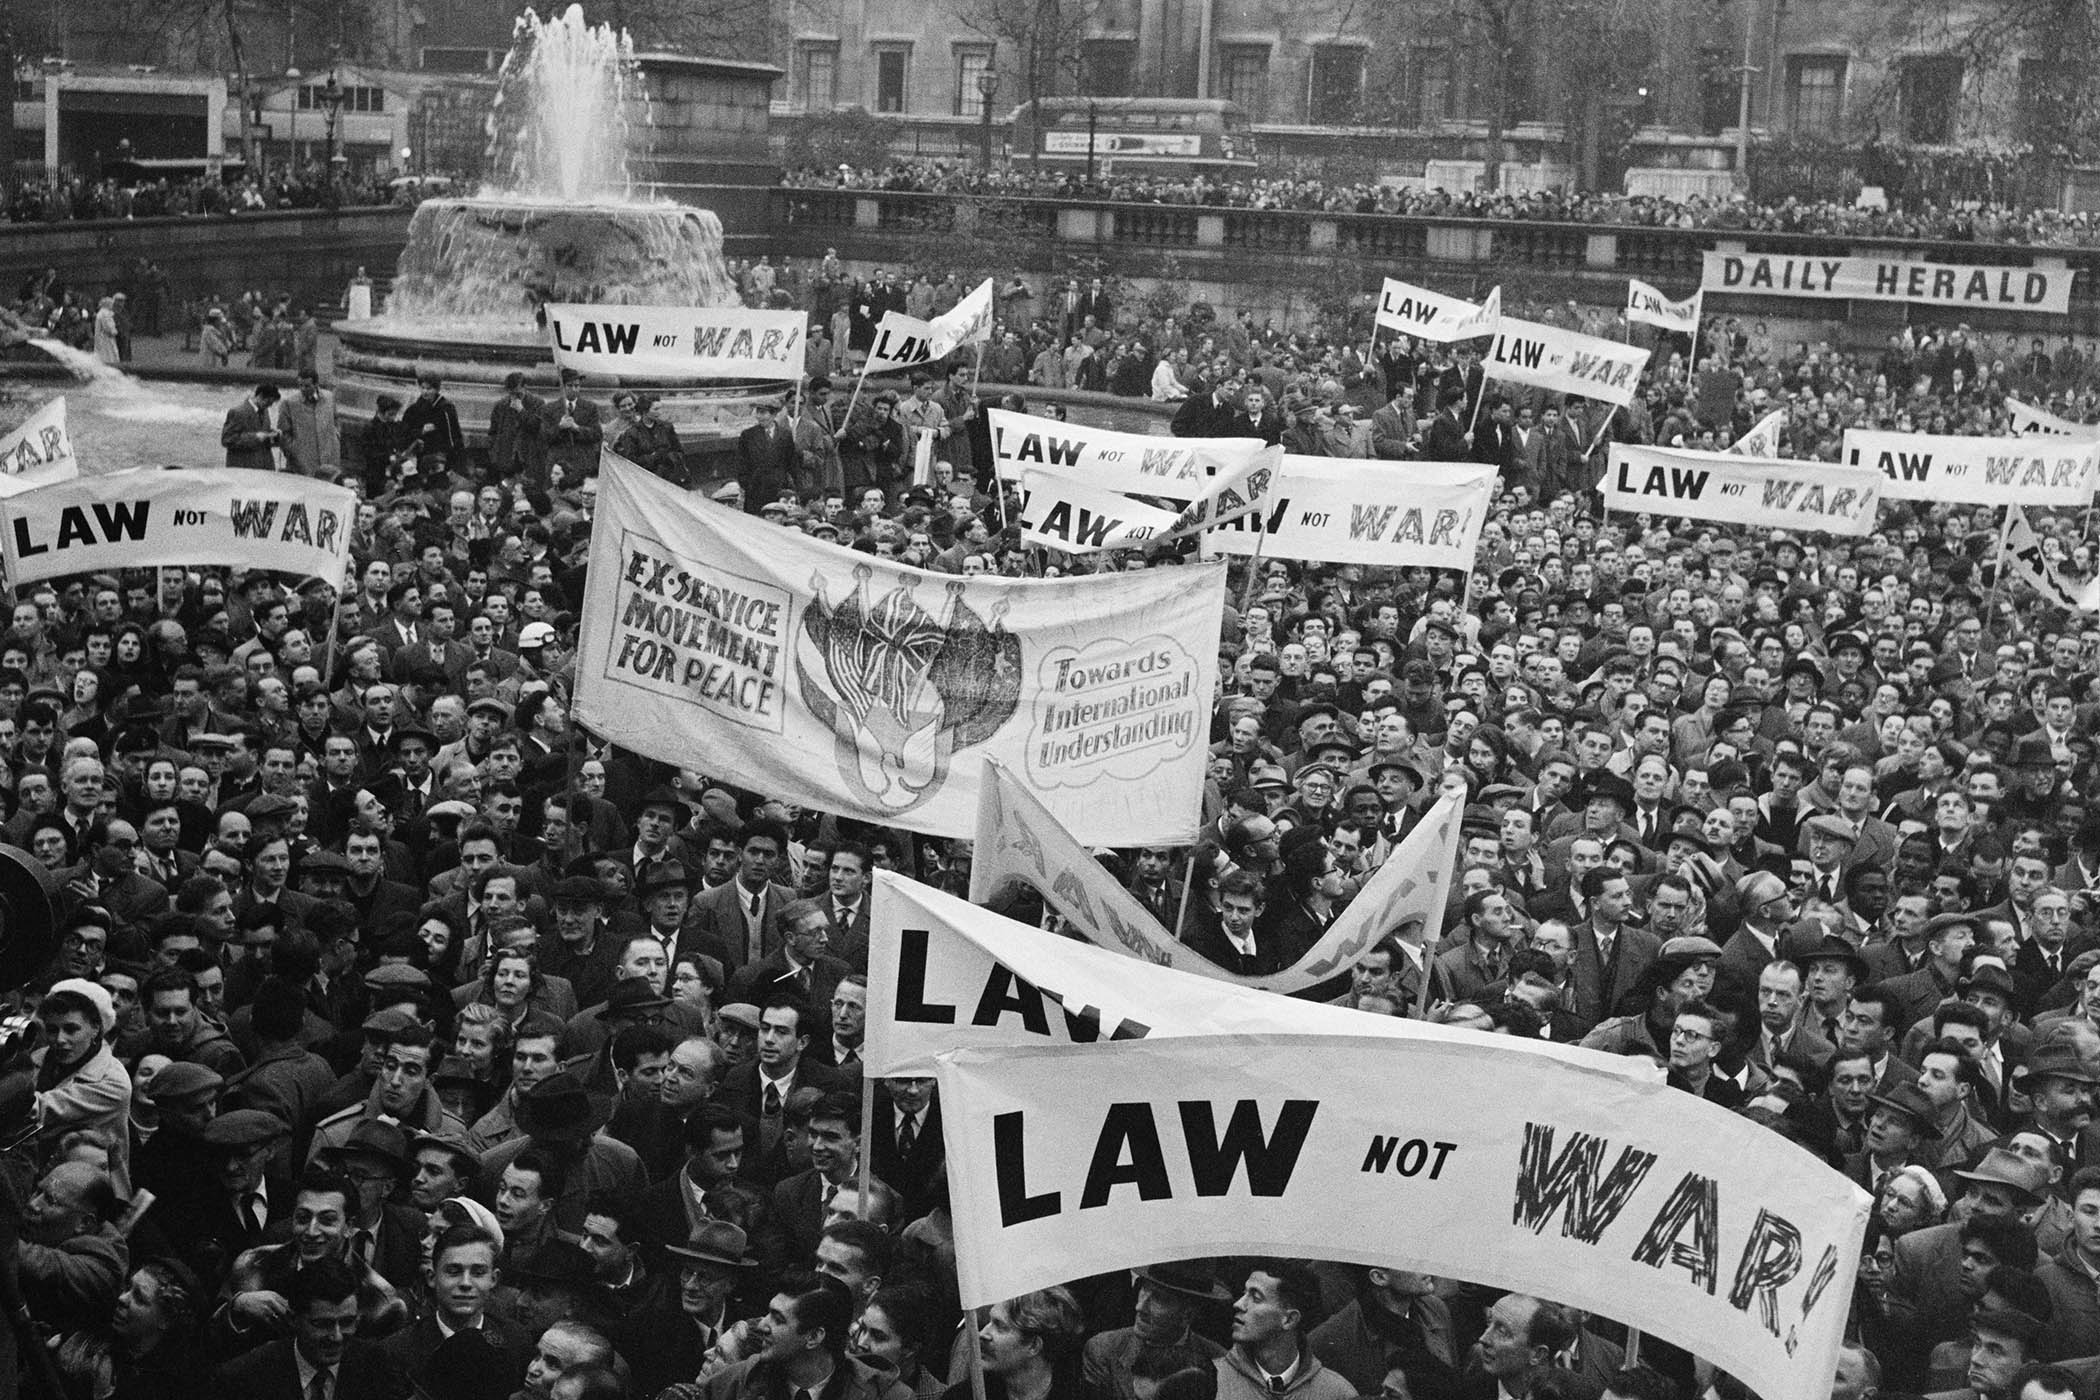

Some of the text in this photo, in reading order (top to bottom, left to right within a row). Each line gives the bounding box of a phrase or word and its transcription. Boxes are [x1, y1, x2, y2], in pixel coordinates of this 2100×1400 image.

[1630, 290, 1663, 316] LAW
[1722, 257, 2048, 304] DAILY HERALD
[1383, 291, 1438, 325] LAW
[553, 320, 799, 363] LAW NOT WAR!
[1495, 334, 1545, 370] LAW
[996, 426, 1198, 480] LAW NOT WA
[1945, 464, 1969, 476] NOT
[1984, 456, 2092, 489] WAR!
[1021, 489, 1123, 547] LAW
[1617, 462, 1874, 520] LAW NOT WAR!
[13, 501, 150, 558] LAW
[173, 510, 207, 526] NOT
[1300, 511, 1331, 528] NOT
[1349, 504, 1472, 549] WAR!
[622, 591, 779, 678] MOVEMENT
[616, 633, 774, 716] FOR PEACE
[1054, 650, 1171, 693] Towards
[1043, 671, 1190, 735] International
[1039, 709, 1193, 769] Understanding
[993, 1099, 1839, 1360] LAW NOT WAR!
